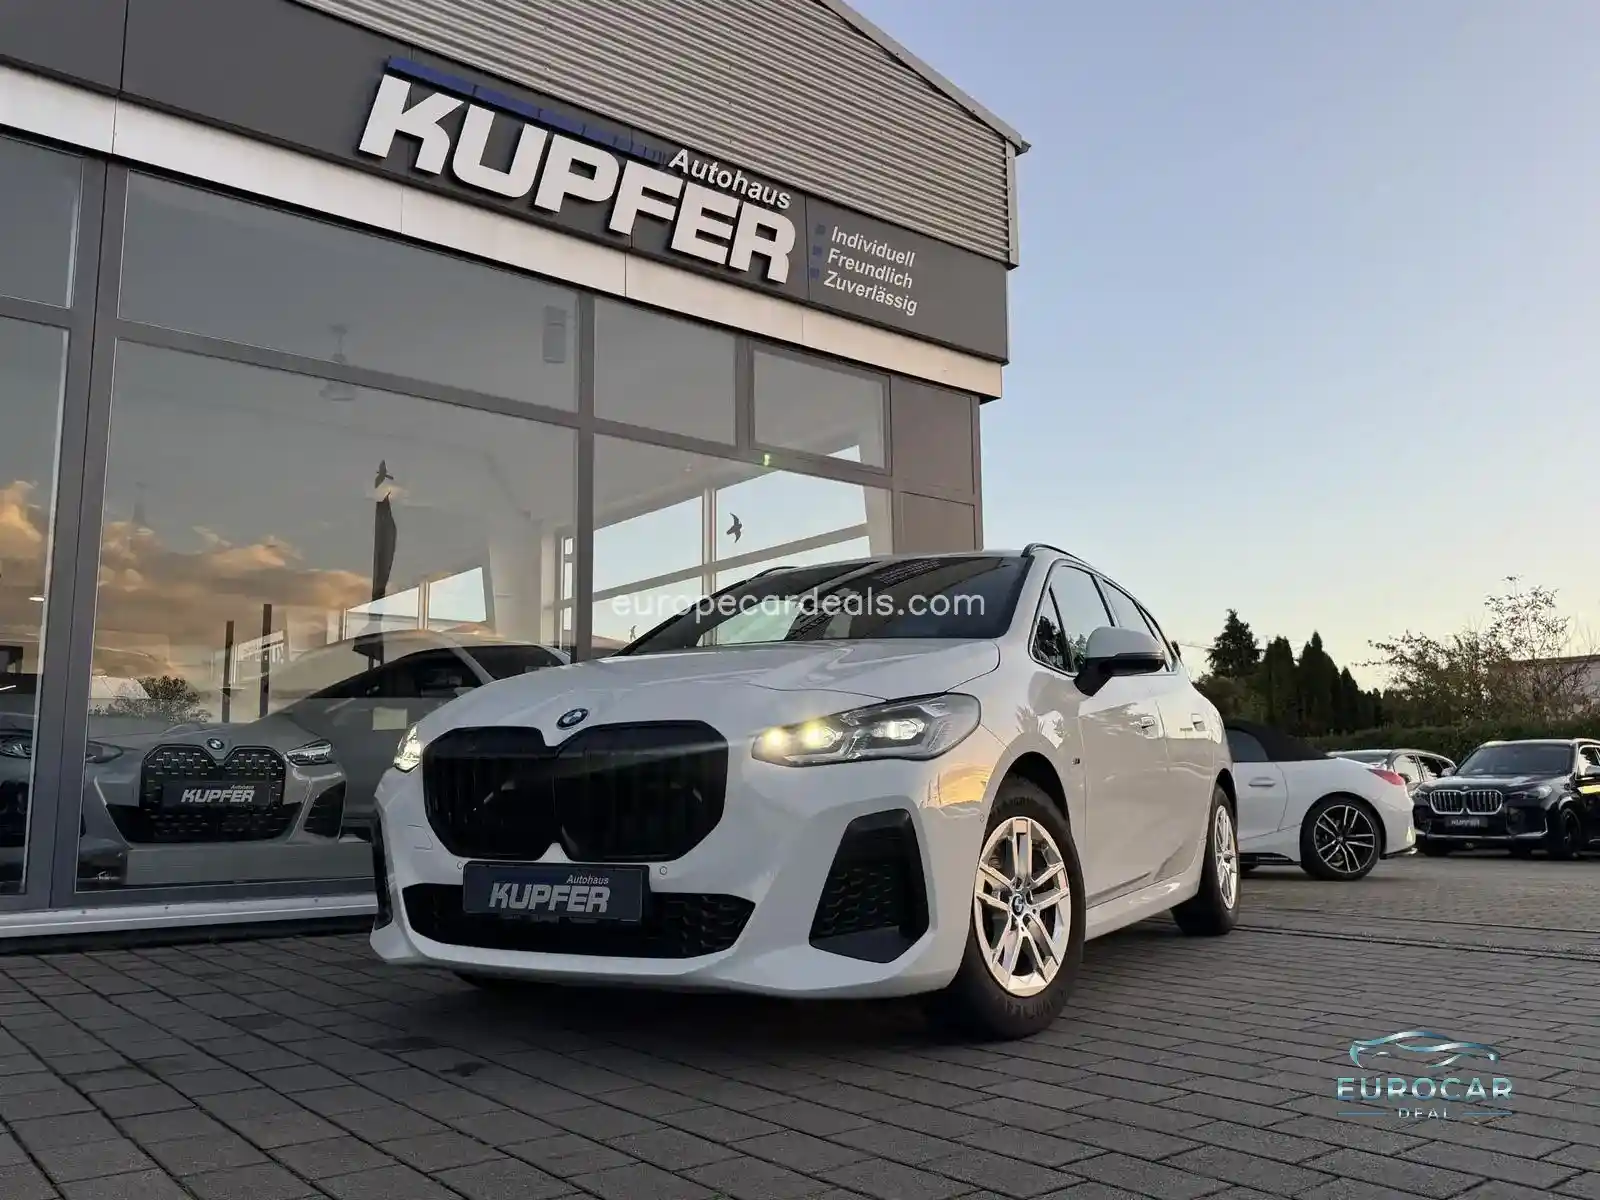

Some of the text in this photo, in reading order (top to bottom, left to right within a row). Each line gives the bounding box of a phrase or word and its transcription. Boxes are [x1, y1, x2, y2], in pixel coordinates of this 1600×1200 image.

[358, 74, 797, 284] KUPFER
[668, 148, 792, 210] Autohaus
[831, 225, 916, 268] Individuell
[827, 247, 913, 289] Freundlich
[823, 270, 918, 316] Zuverlässig
[180, 789, 255, 803] KUPFER
[488, 882, 611, 913] KUPFER
[566, 874, 609, 885] Autohaus
